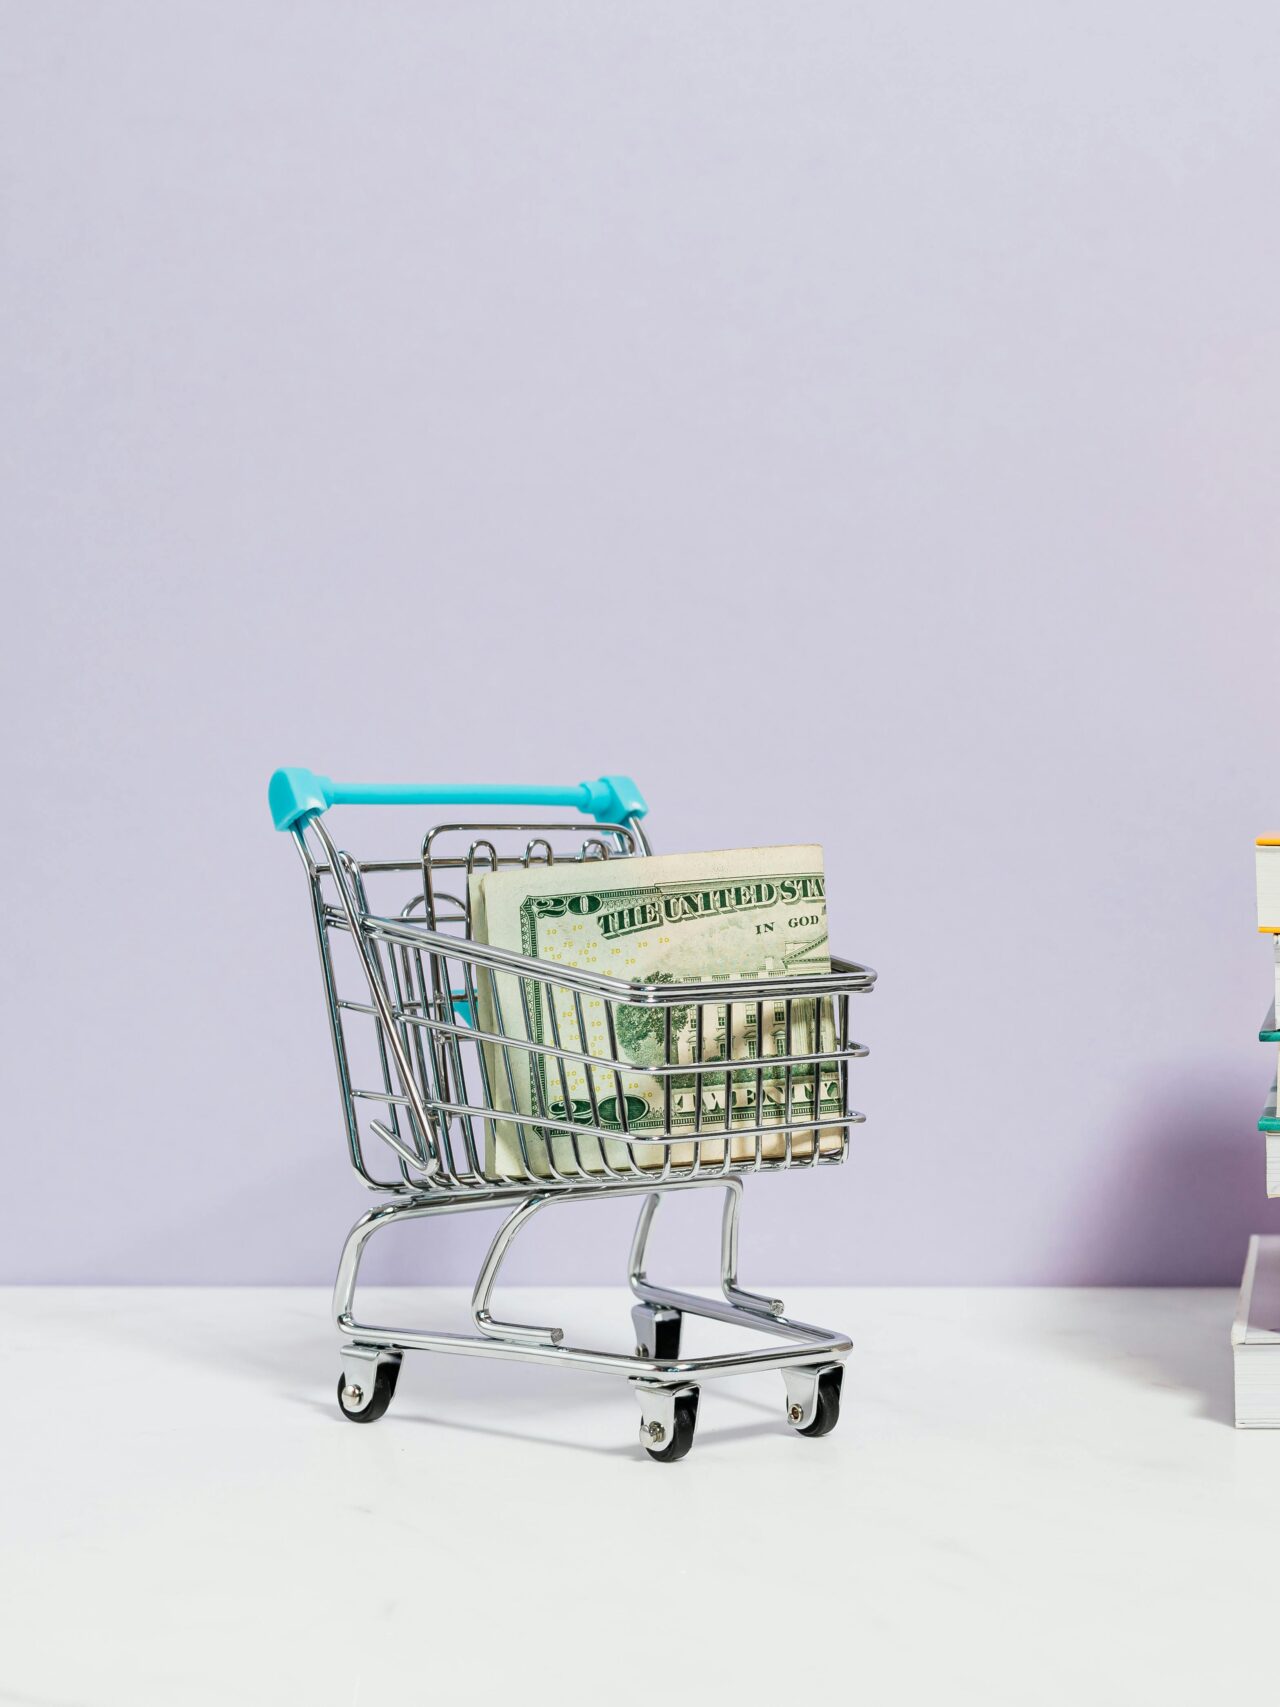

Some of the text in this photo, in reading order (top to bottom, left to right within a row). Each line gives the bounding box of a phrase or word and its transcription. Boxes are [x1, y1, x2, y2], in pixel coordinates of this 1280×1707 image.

[533, 895, 602, 918] 20
[598, 902, 663, 939] THE
[664, 882, 778, 923] UNITED
[755, 914, 819, 935] IN GOD
[549, 1095, 649, 1125] 20
